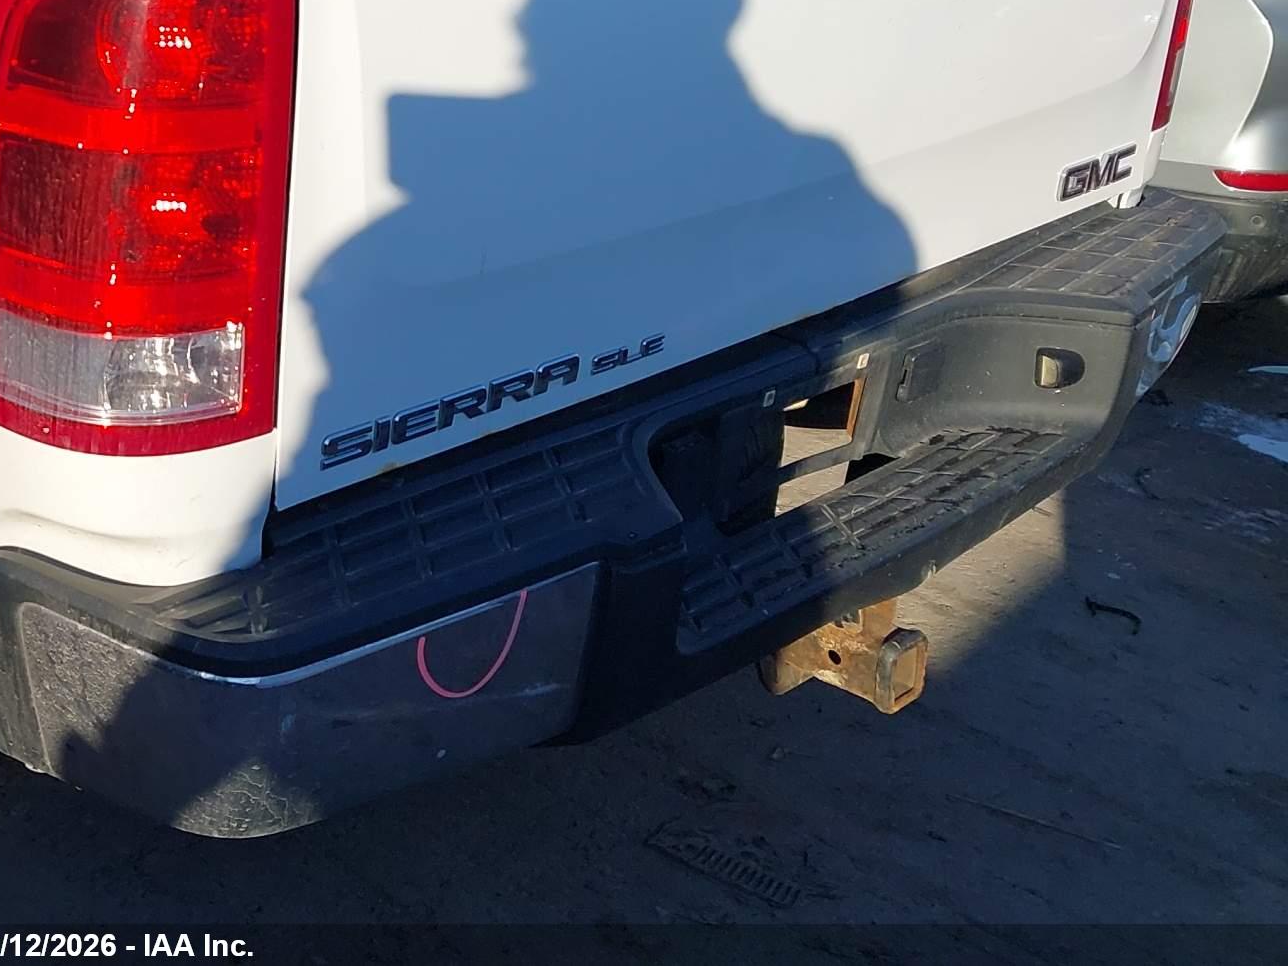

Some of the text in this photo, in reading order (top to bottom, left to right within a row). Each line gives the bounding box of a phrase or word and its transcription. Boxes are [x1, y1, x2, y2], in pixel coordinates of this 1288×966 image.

[1058, 144, 1137, 201] GMC
[320, 334, 665, 470] SIERRA SLE
